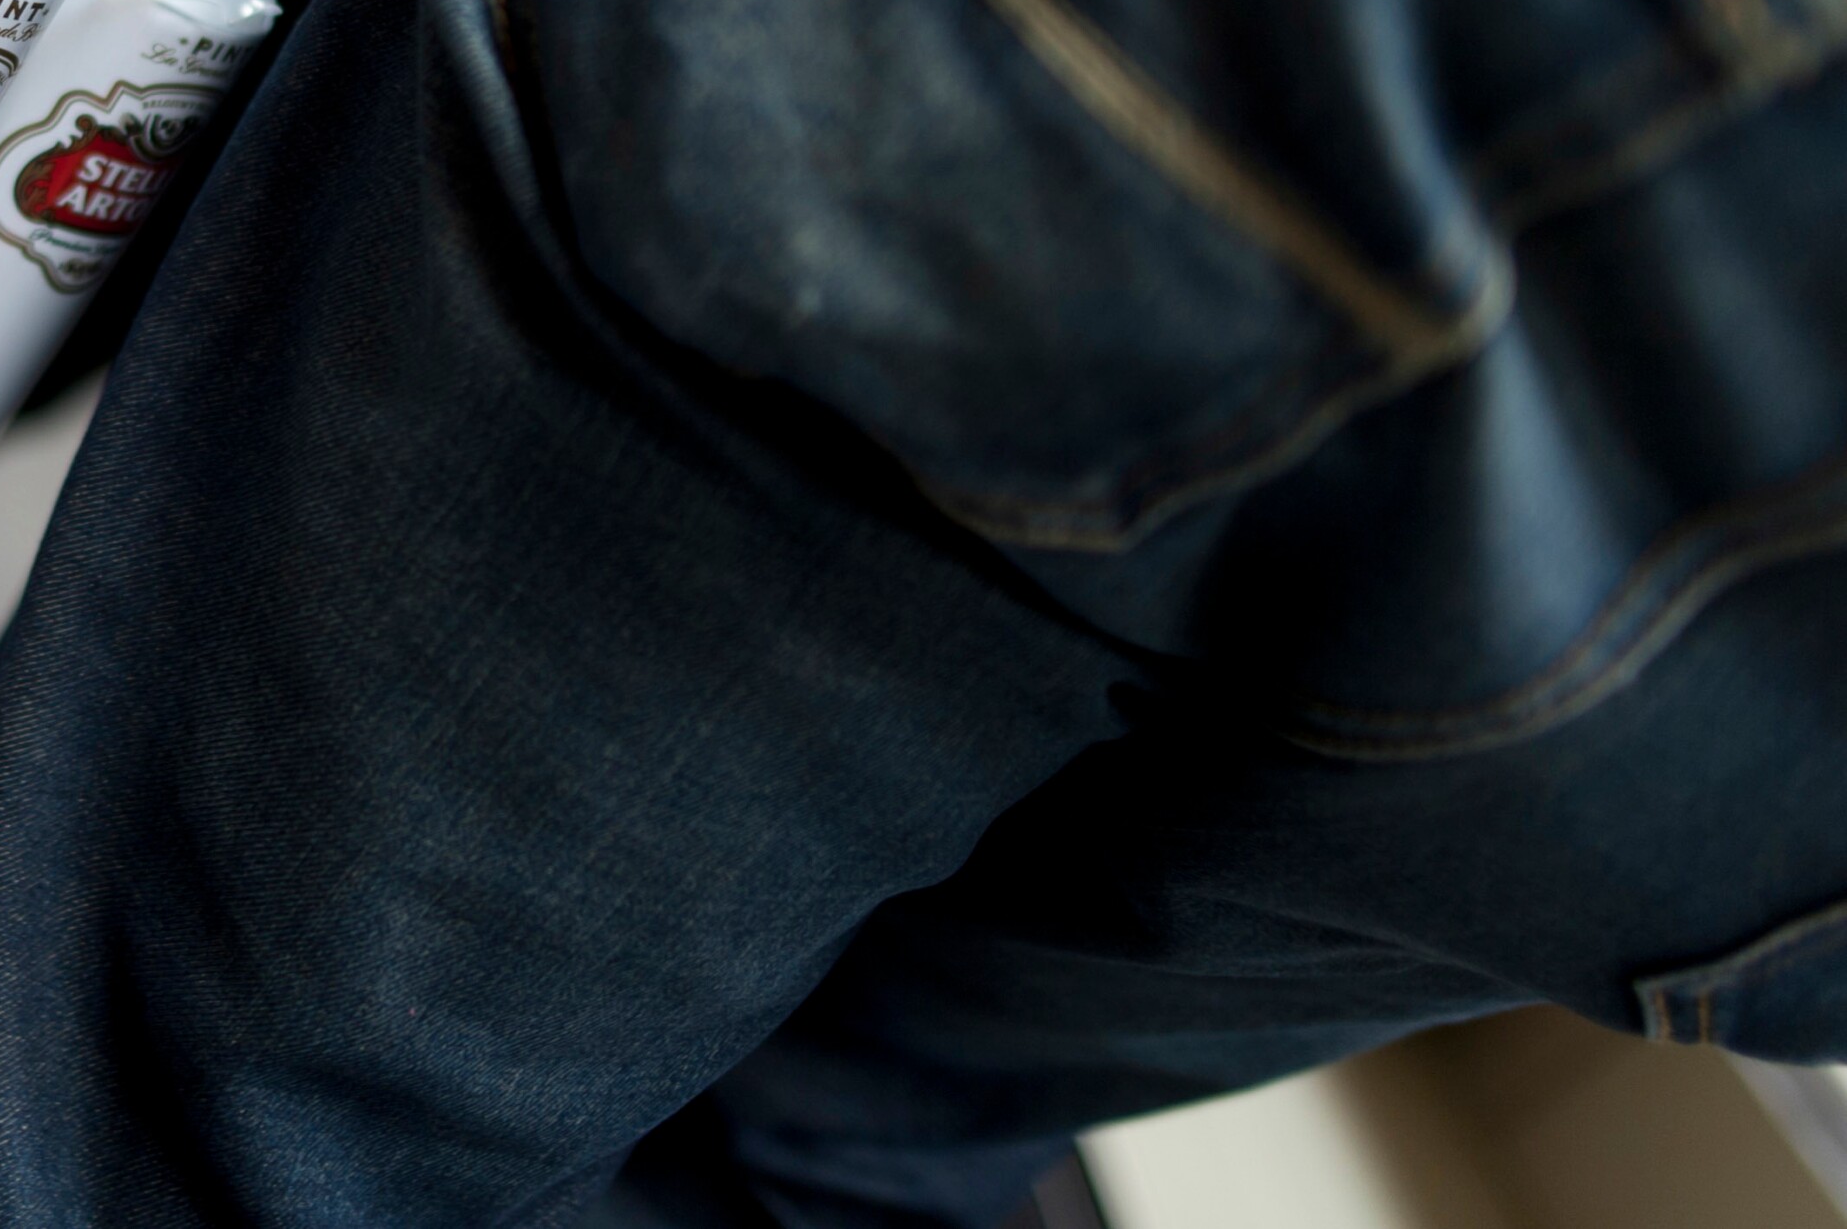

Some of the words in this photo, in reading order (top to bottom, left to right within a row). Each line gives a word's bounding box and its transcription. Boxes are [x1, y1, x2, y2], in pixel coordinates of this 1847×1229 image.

[191, 37, 248, 64] PIN
[75, 152, 170, 195] STELL
[54, 183, 148, 224] ARTO
